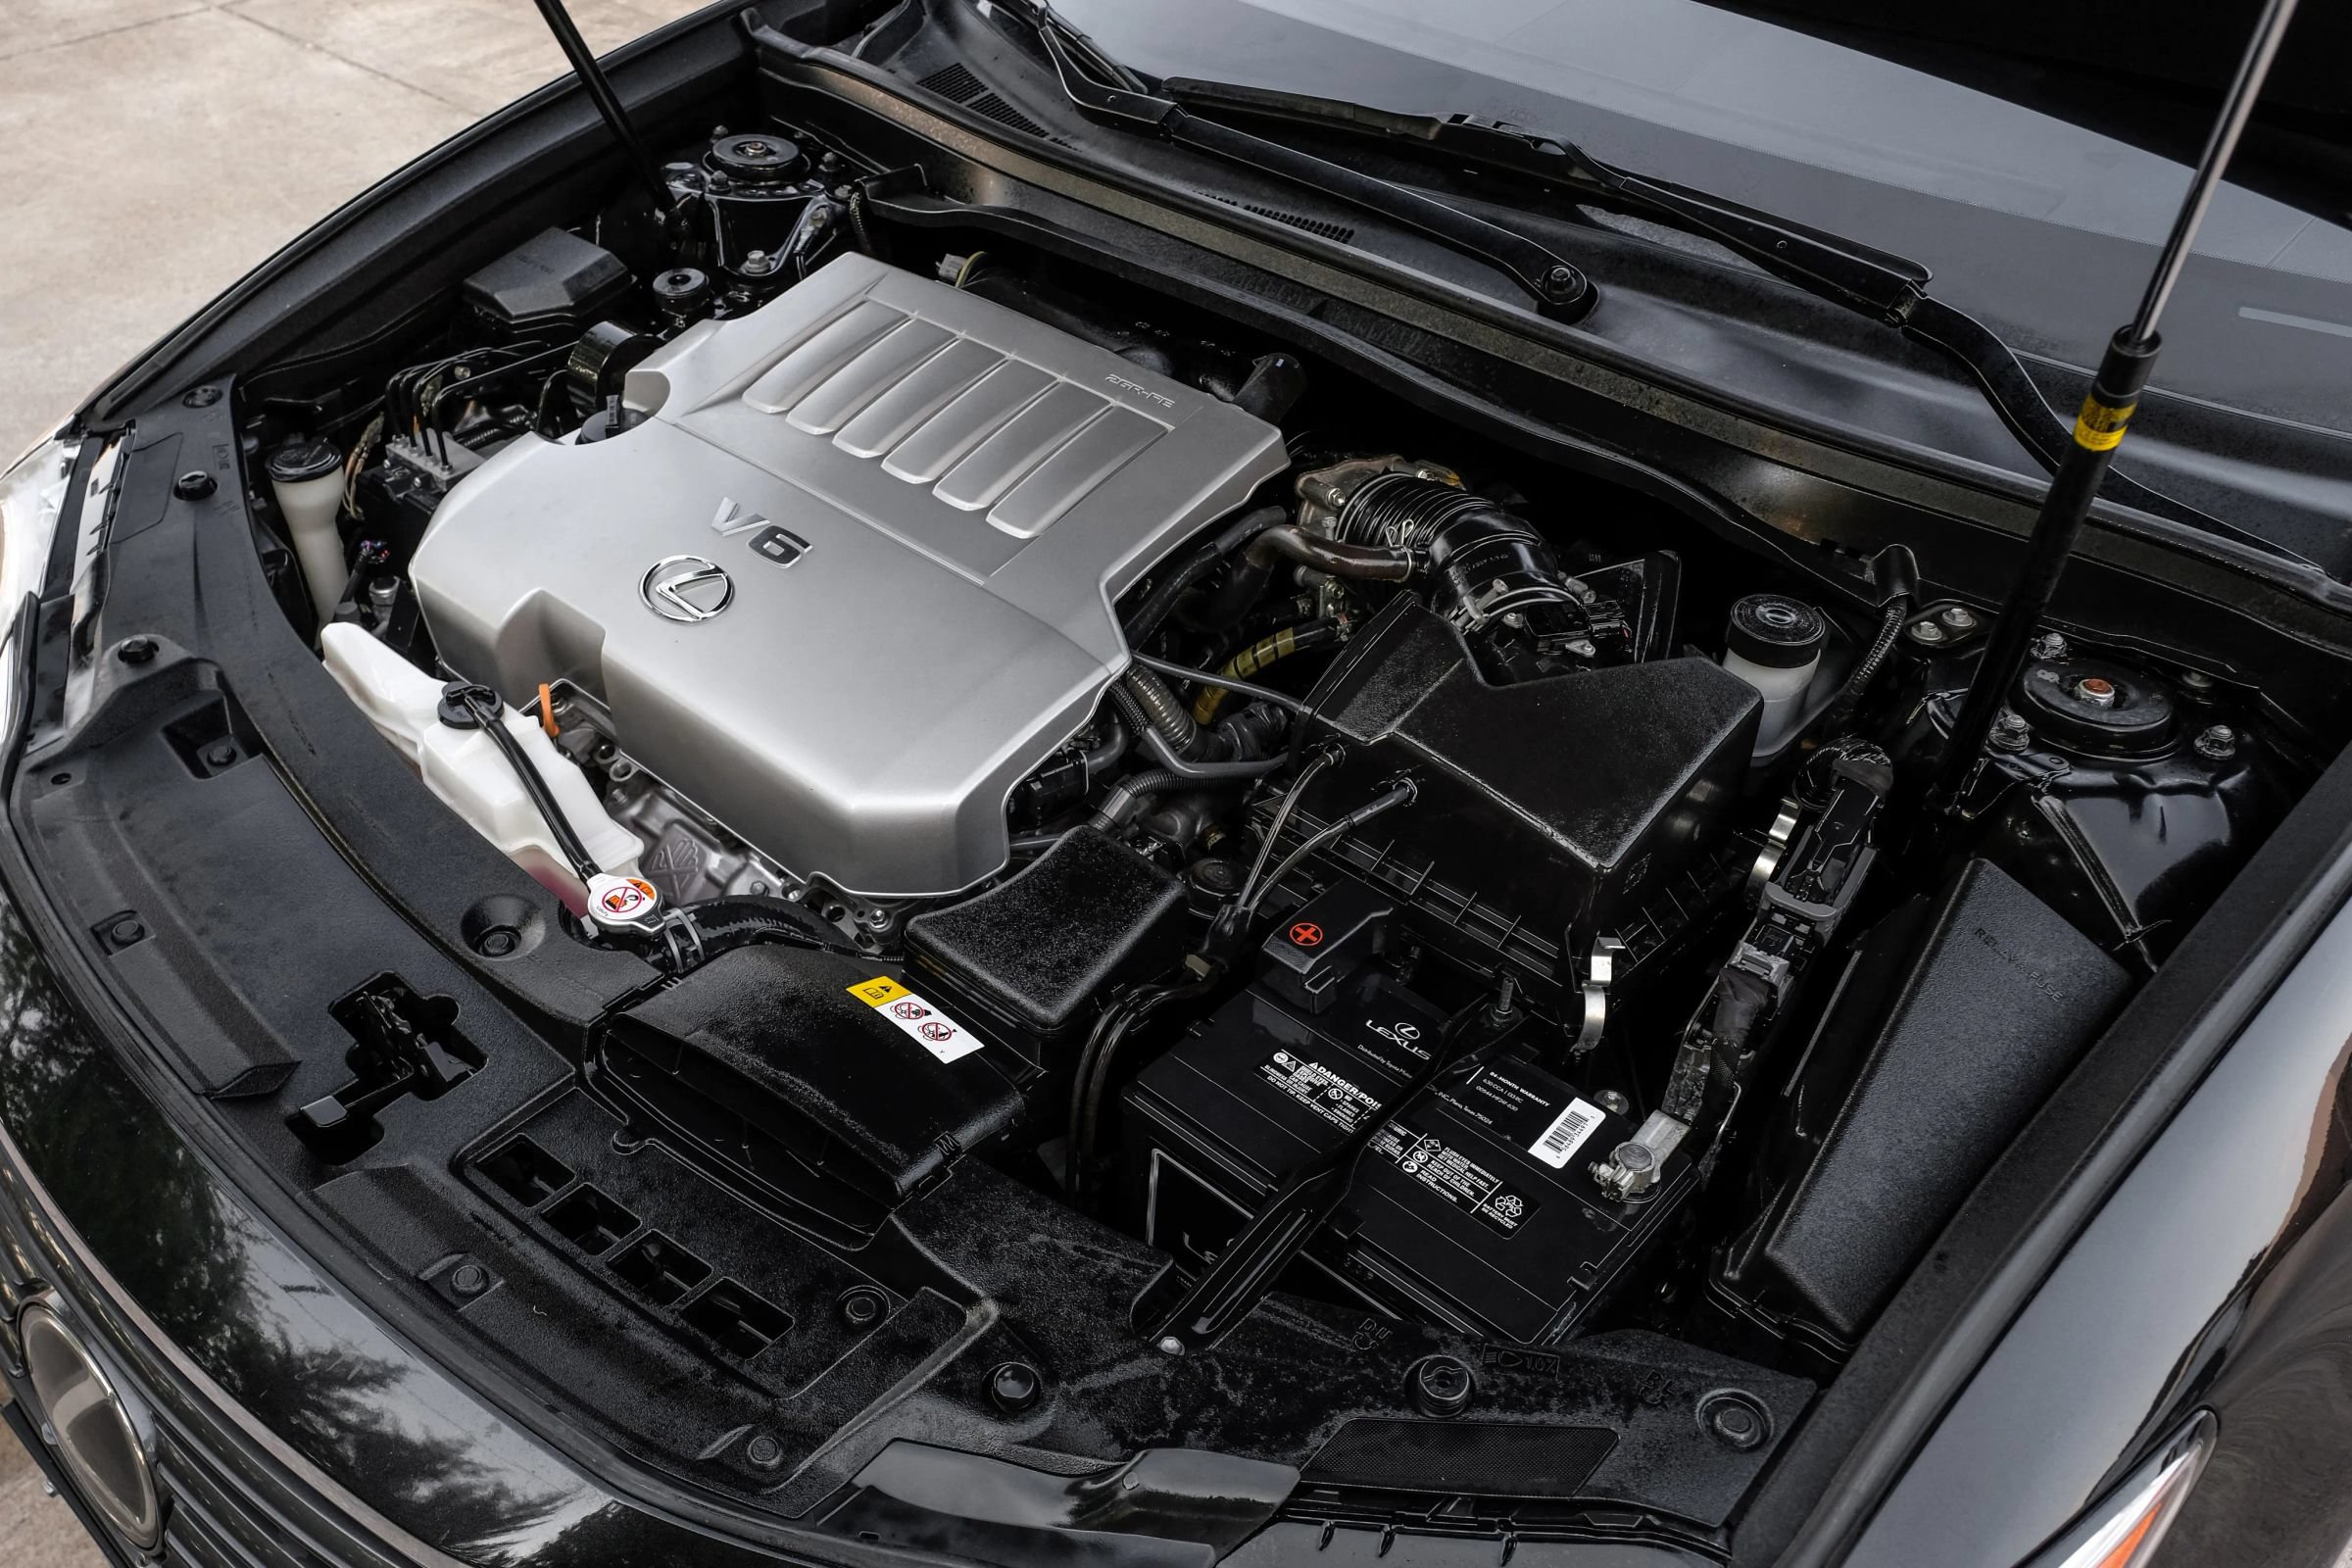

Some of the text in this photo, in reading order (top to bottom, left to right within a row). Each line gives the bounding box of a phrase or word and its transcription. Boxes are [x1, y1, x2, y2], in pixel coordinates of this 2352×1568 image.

[1104, 373, 1176, 409] 2GR-FE
[711, 496, 813, 569] V6
[2029, 971, 2065, 1004] FUSE
[1365, 1019, 1433, 1061] LEXUS
[1263, 1064, 1288, 1081] BLINDNESS
[1386, 1060, 1399, 1072] Toyota
[1297, 1081, 1312, 1091] CAUSE
[1481, 1078, 1494, 1087] 630
[1491, 1084, 1504, 1093] CCA
[1488, 1071, 1550, 1107] 84-MONTH WARRANTY
[1274, 1081, 1287, 1090] NOT
[1295, 1094, 1310, 1104] KEEP
[1308, 1102, 1324, 1113] VENT
[1322, 1112, 1340, 1123] CAPS
[1461, 1105, 1477, 1115] Texas
[1440, 1150, 1453, 1159] WITH
[1419, 1169, 1438, 1182] READ
[1426, 1163, 1445, 1176] REACH
[1429, 1159, 1444, 1169] KEEP
[1442, 1167, 1453, 1176] OUT
[1445, 1158, 1466, 1173] MEDICAL
[1463, 1171, 1477, 1180] HELP
[1457, 1155, 1471, 1165] EYES
[1468, 1162, 1499, 1183] IMMEDIATELY
[1482, 1202, 1518, 1227] BATTERY MUST
[1487, 1211, 1514, 1229] RECYCLED
